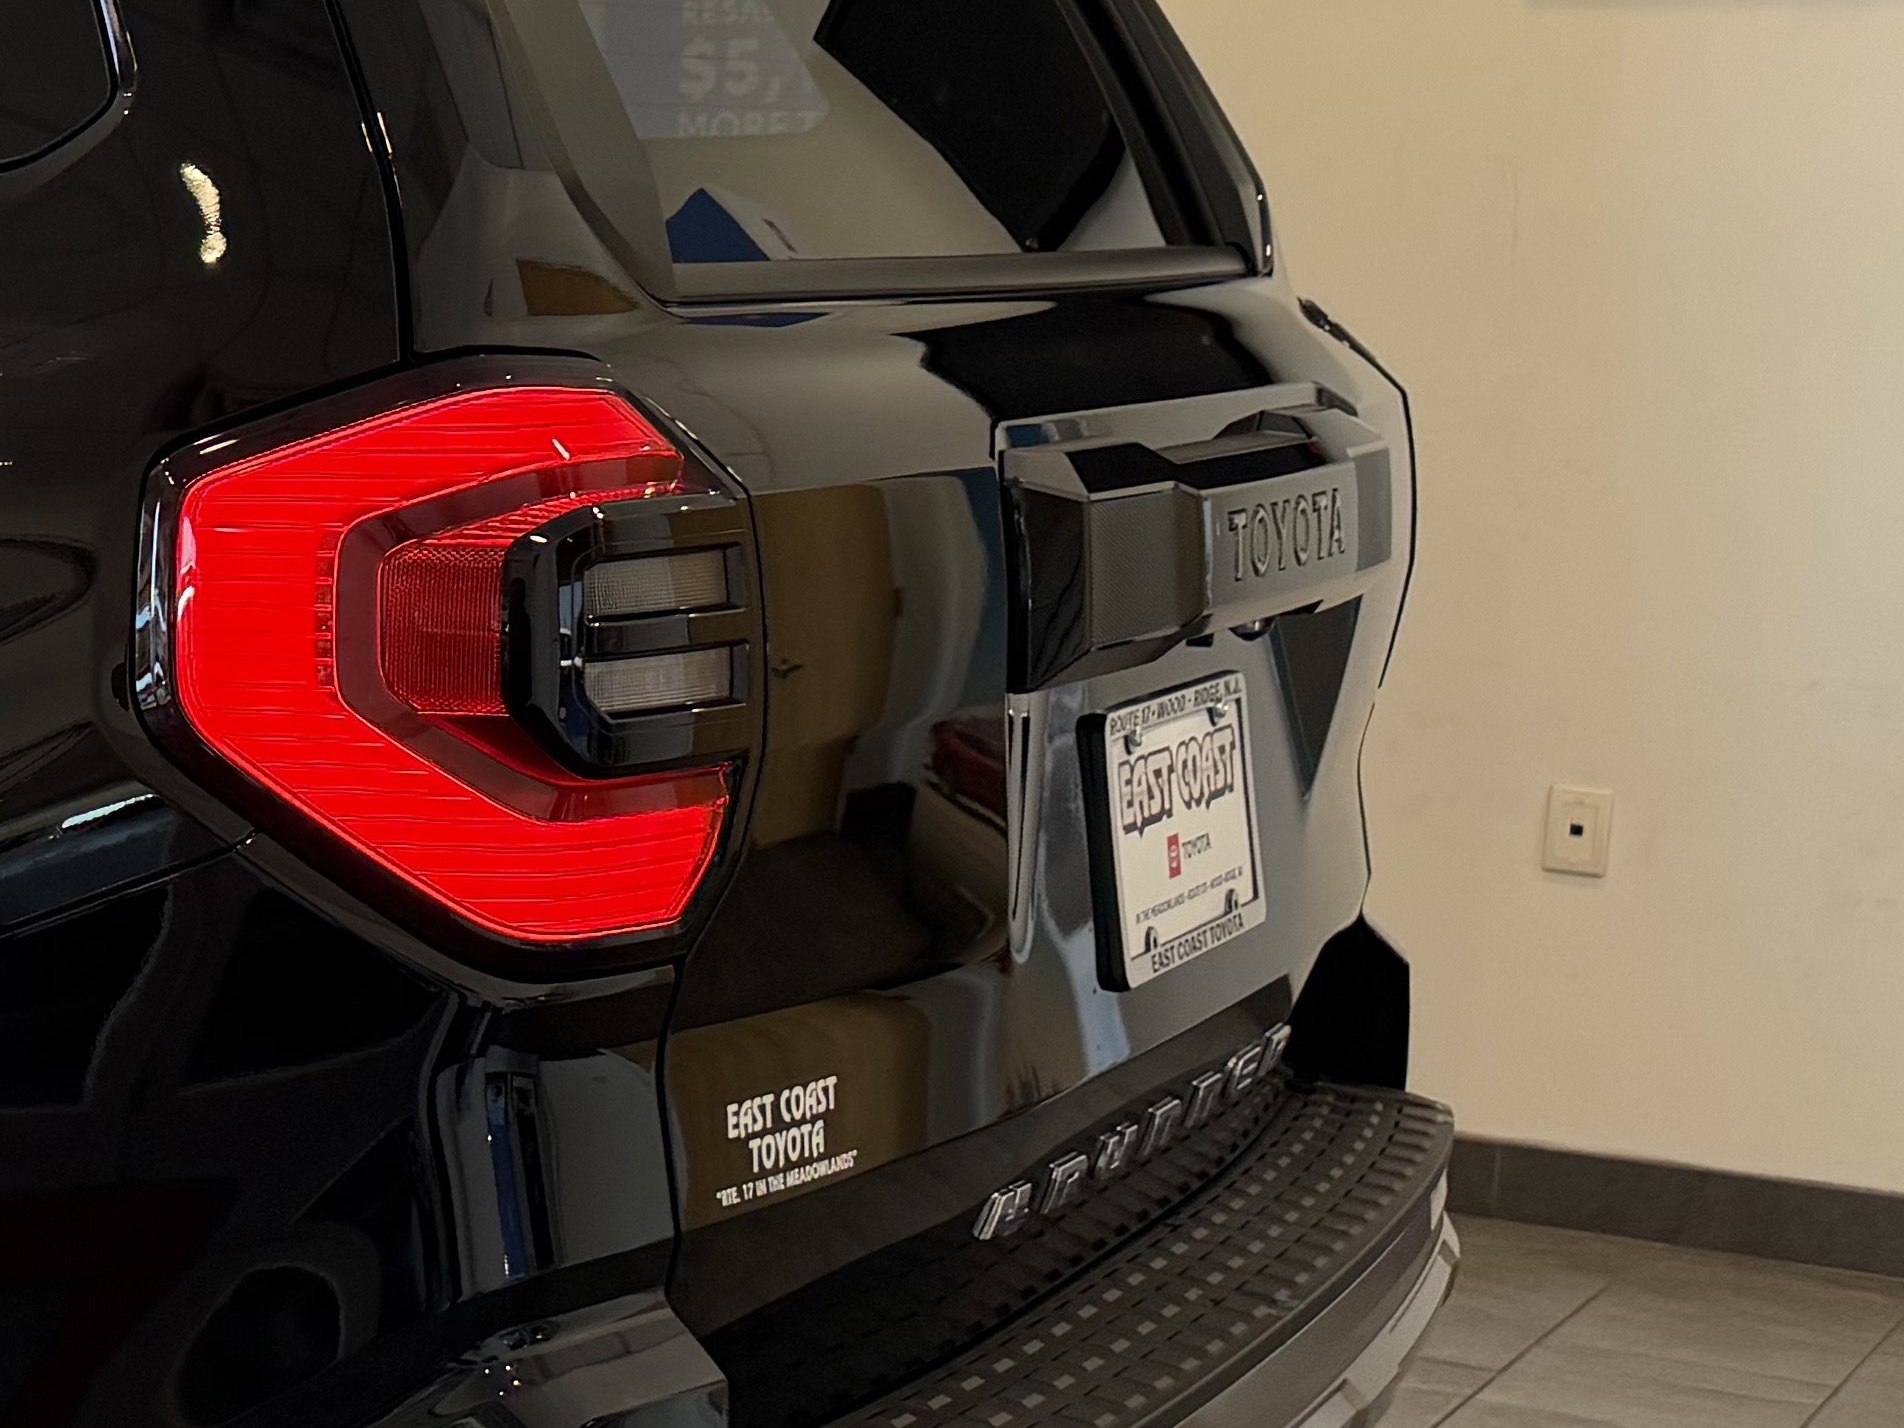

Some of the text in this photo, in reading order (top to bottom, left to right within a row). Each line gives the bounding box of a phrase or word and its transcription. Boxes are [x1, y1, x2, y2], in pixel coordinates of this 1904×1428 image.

[1227, 488, 1345, 581] TOYOTA
[1118, 724, 1236, 838] EAST COAST
[1182, 833, 1212, 860] TOYOTA
[1151, 913, 1244, 974] EAST COAST TOYOTA
[726, 1075, 838, 1139] EAST COAST
[748, 1119, 825, 1173] TOYOTA
[742, 1183, 754, 1200] 17
[756, 1178, 767, 1196] IN
[767, 1173, 785, 1192] THE
